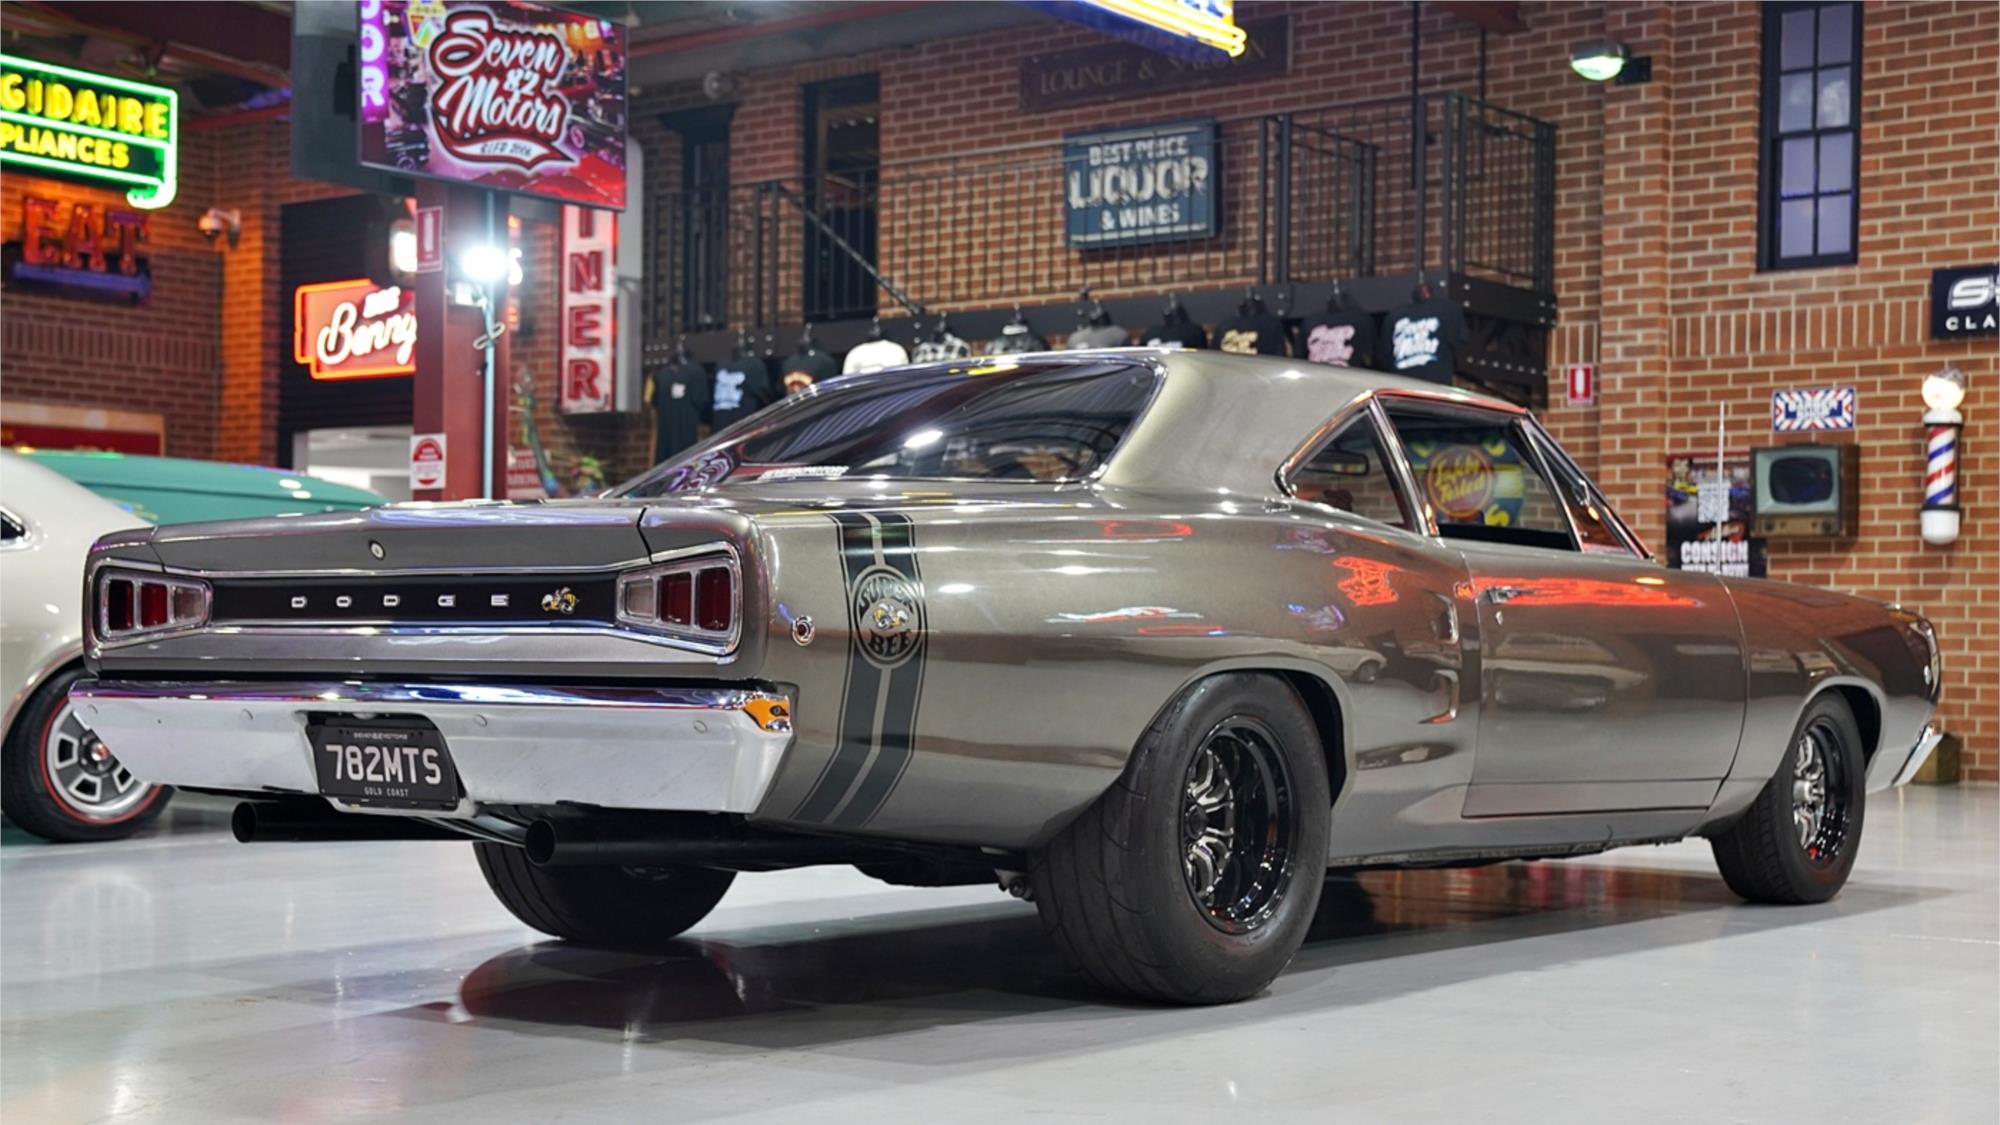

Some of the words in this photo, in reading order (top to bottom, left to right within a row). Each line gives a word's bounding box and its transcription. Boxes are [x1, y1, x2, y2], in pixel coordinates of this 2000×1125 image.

[435, 18, 558, 77] Seven
[503, 68, 540, 96] 82
[1040, 58, 1130, 95] LOUNGE
[438, 75, 563, 137] Motors
[1089, 141, 1132, 166] BEST
[1135, 135, 1189, 160] PRICE
[1068, 156, 1209, 210] LIQUOR
[1118, 202, 1181, 229] WINES
[24, 196, 149, 276] EAT
[1680, 540, 1749, 563] CONSIGN
[291, 595, 511, 608] DODGE
[859, 576, 915, 622] SUPER
[868, 629, 913, 656] BEE
[325, 744, 441, 784] 782MTS
[386, 788, 409, 797] COAST
